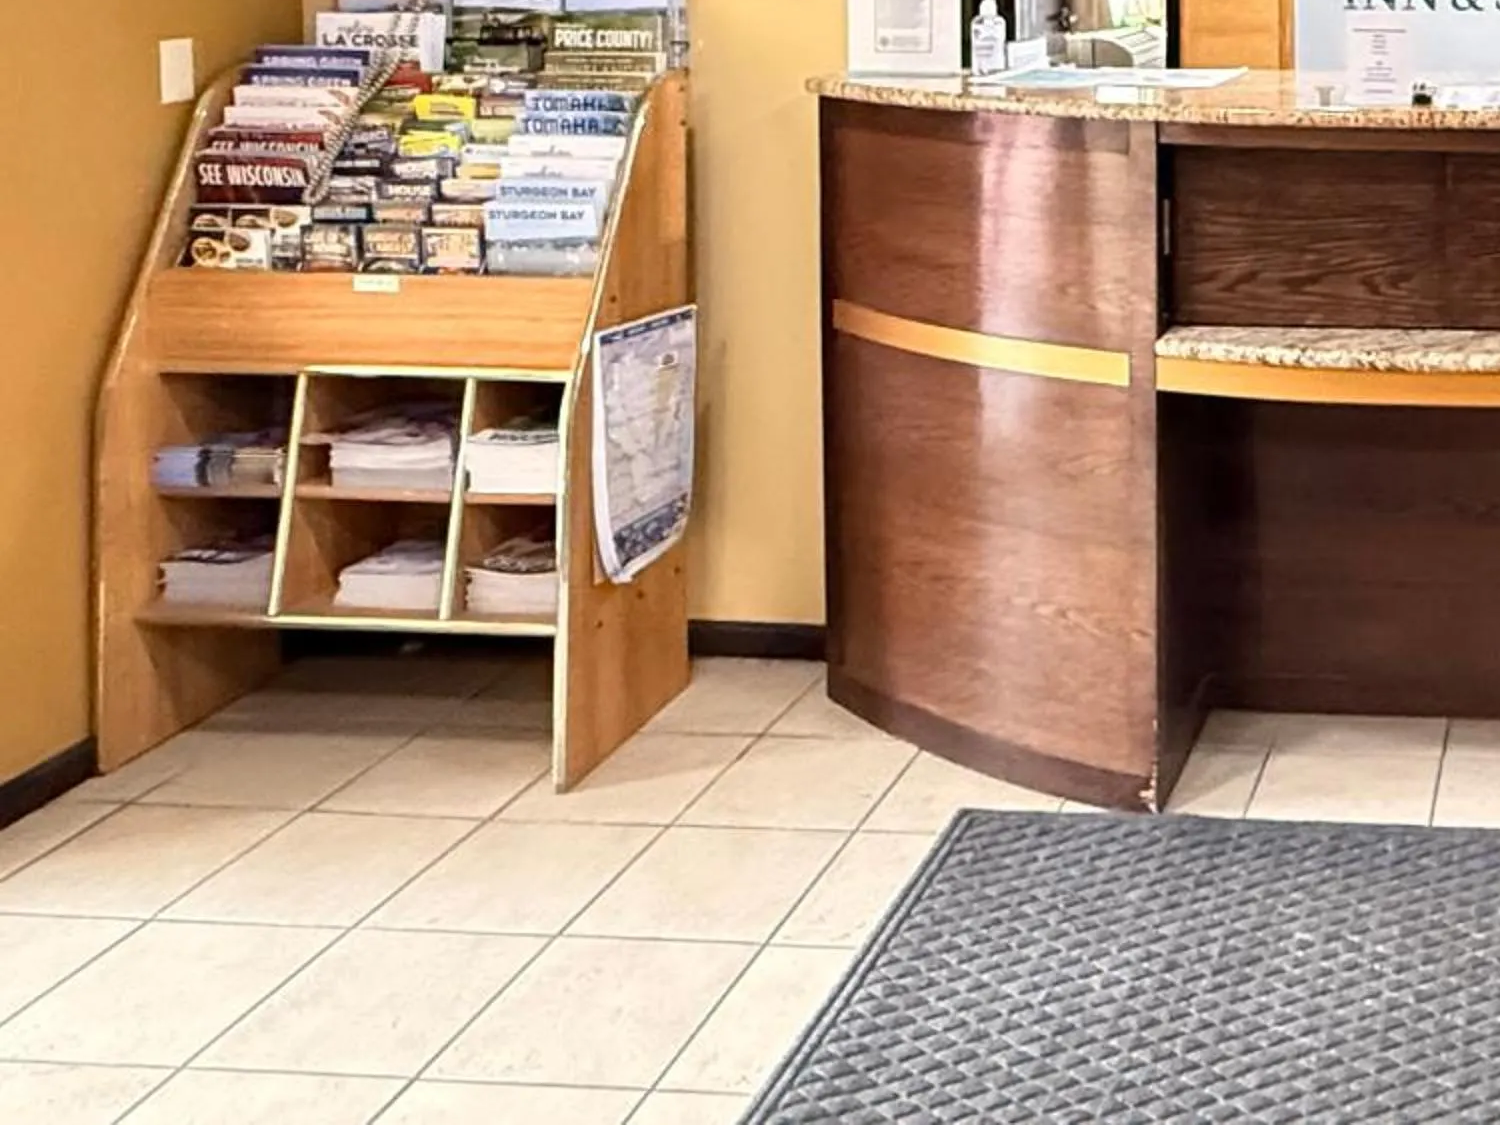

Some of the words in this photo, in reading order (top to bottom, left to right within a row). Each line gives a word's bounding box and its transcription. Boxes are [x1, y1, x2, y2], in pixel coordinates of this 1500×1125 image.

[322, 32, 347, 47] LA
[554, 28, 594, 49] PRICE
[198, 163, 223, 185] SEE
[226, 163, 308, 188] WISCONSIN
[571, 186, 598, 199] BAY
